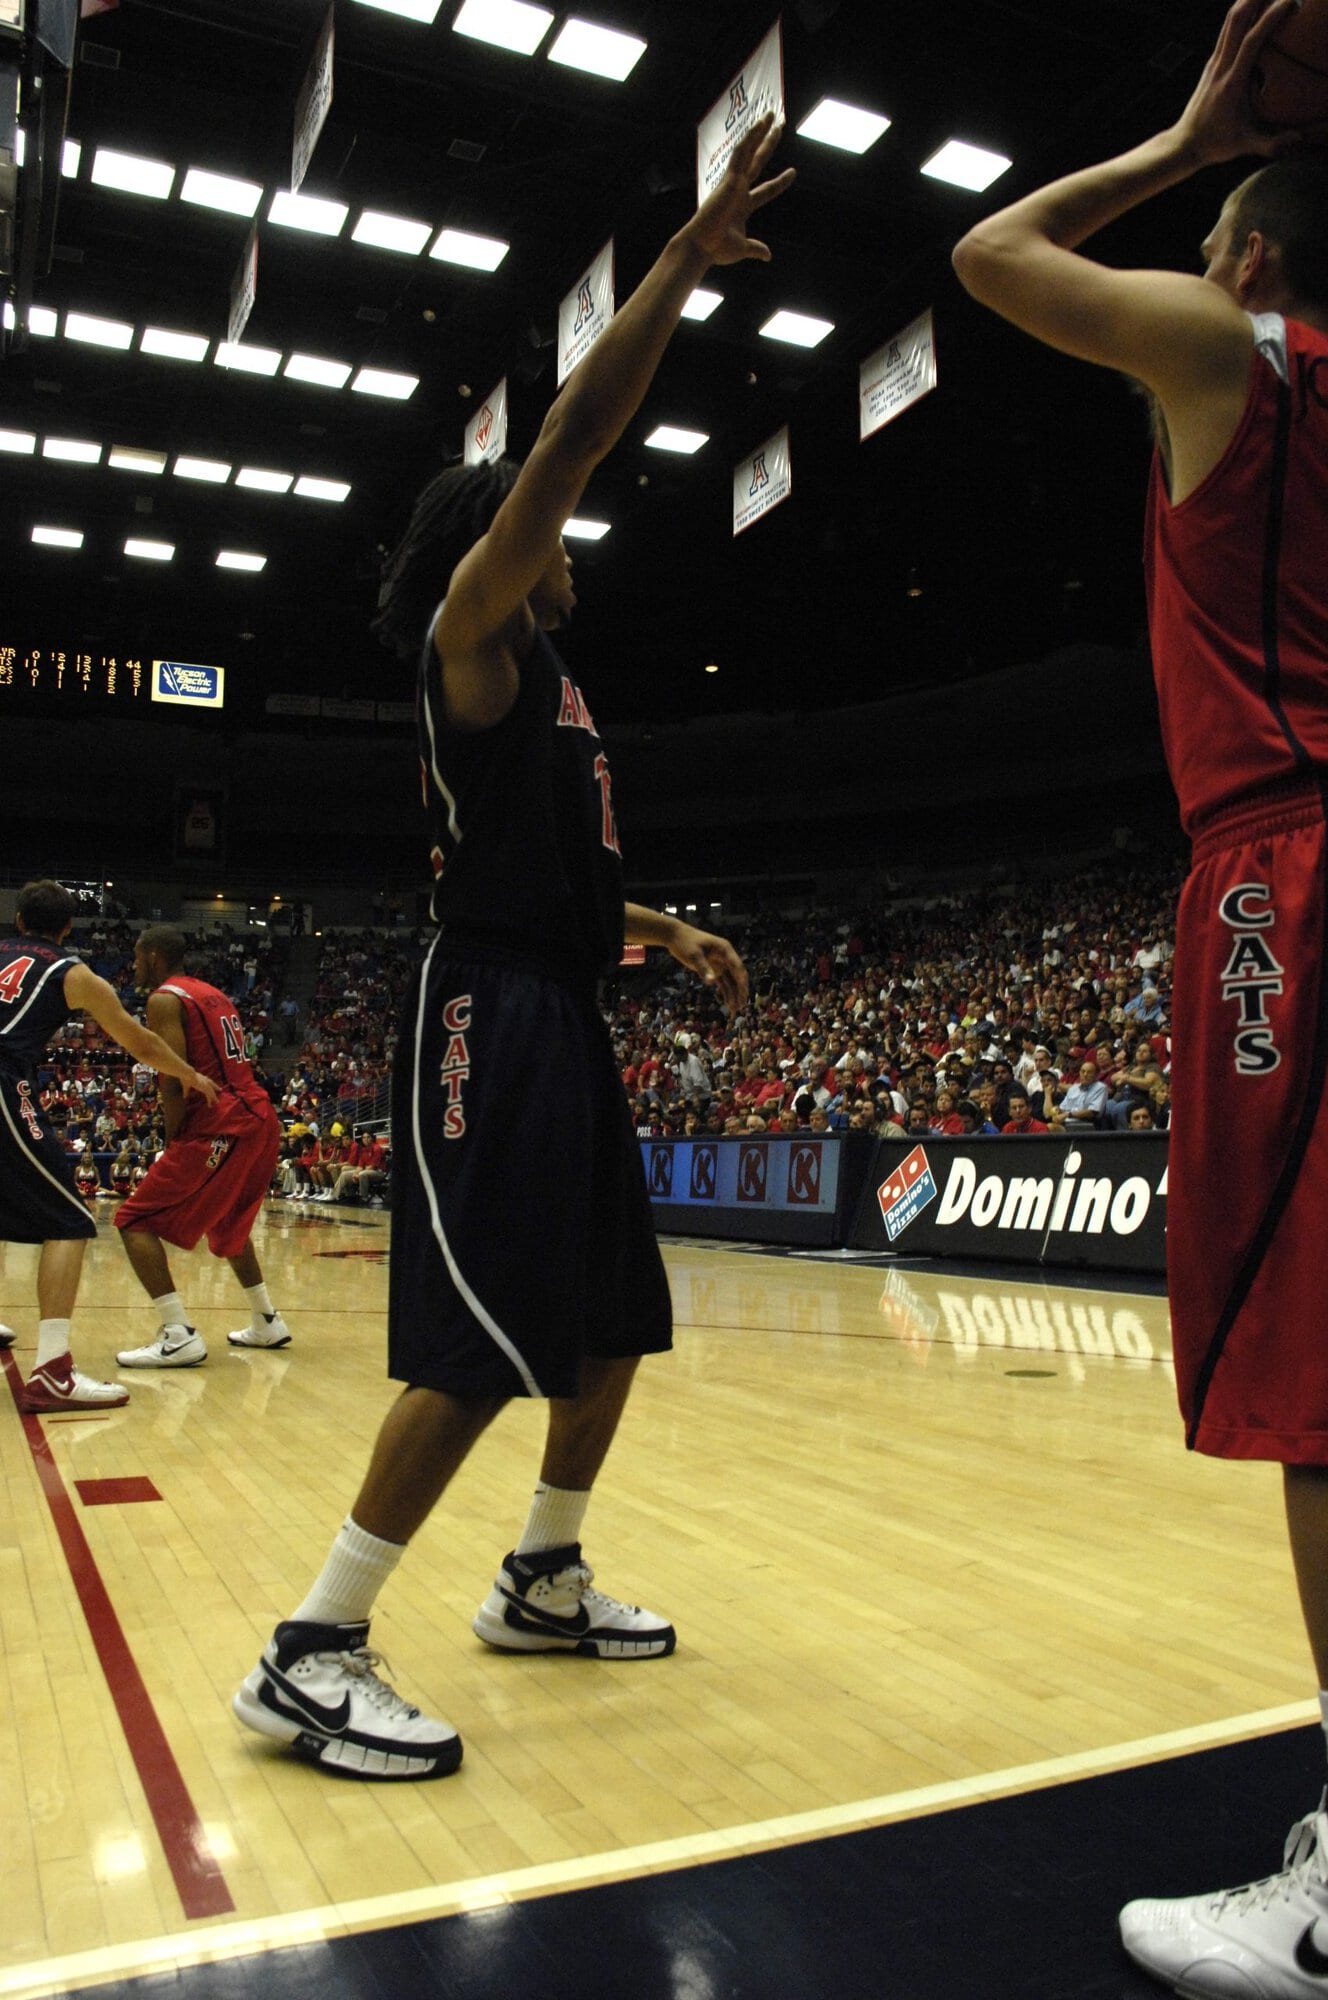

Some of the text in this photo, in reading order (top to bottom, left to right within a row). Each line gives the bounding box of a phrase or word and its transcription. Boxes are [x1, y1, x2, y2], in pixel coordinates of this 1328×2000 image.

[126, 660, 141, 669] 44
[174, 667, 206, 678] Tucson
[176, 675, 212, 686] Electric
[180, 684, 212, 694] Power
[1219, 883, 1285, 1075] CATS
[441, 994, 472, 1139] CATS
[17, 1080, 44, 1140] CATS
[888, 1176, 929, 1225] Domino's
[936, 1151, 1168, 1235] Domino'
[890, 1204, 918, 1237] Pizza
